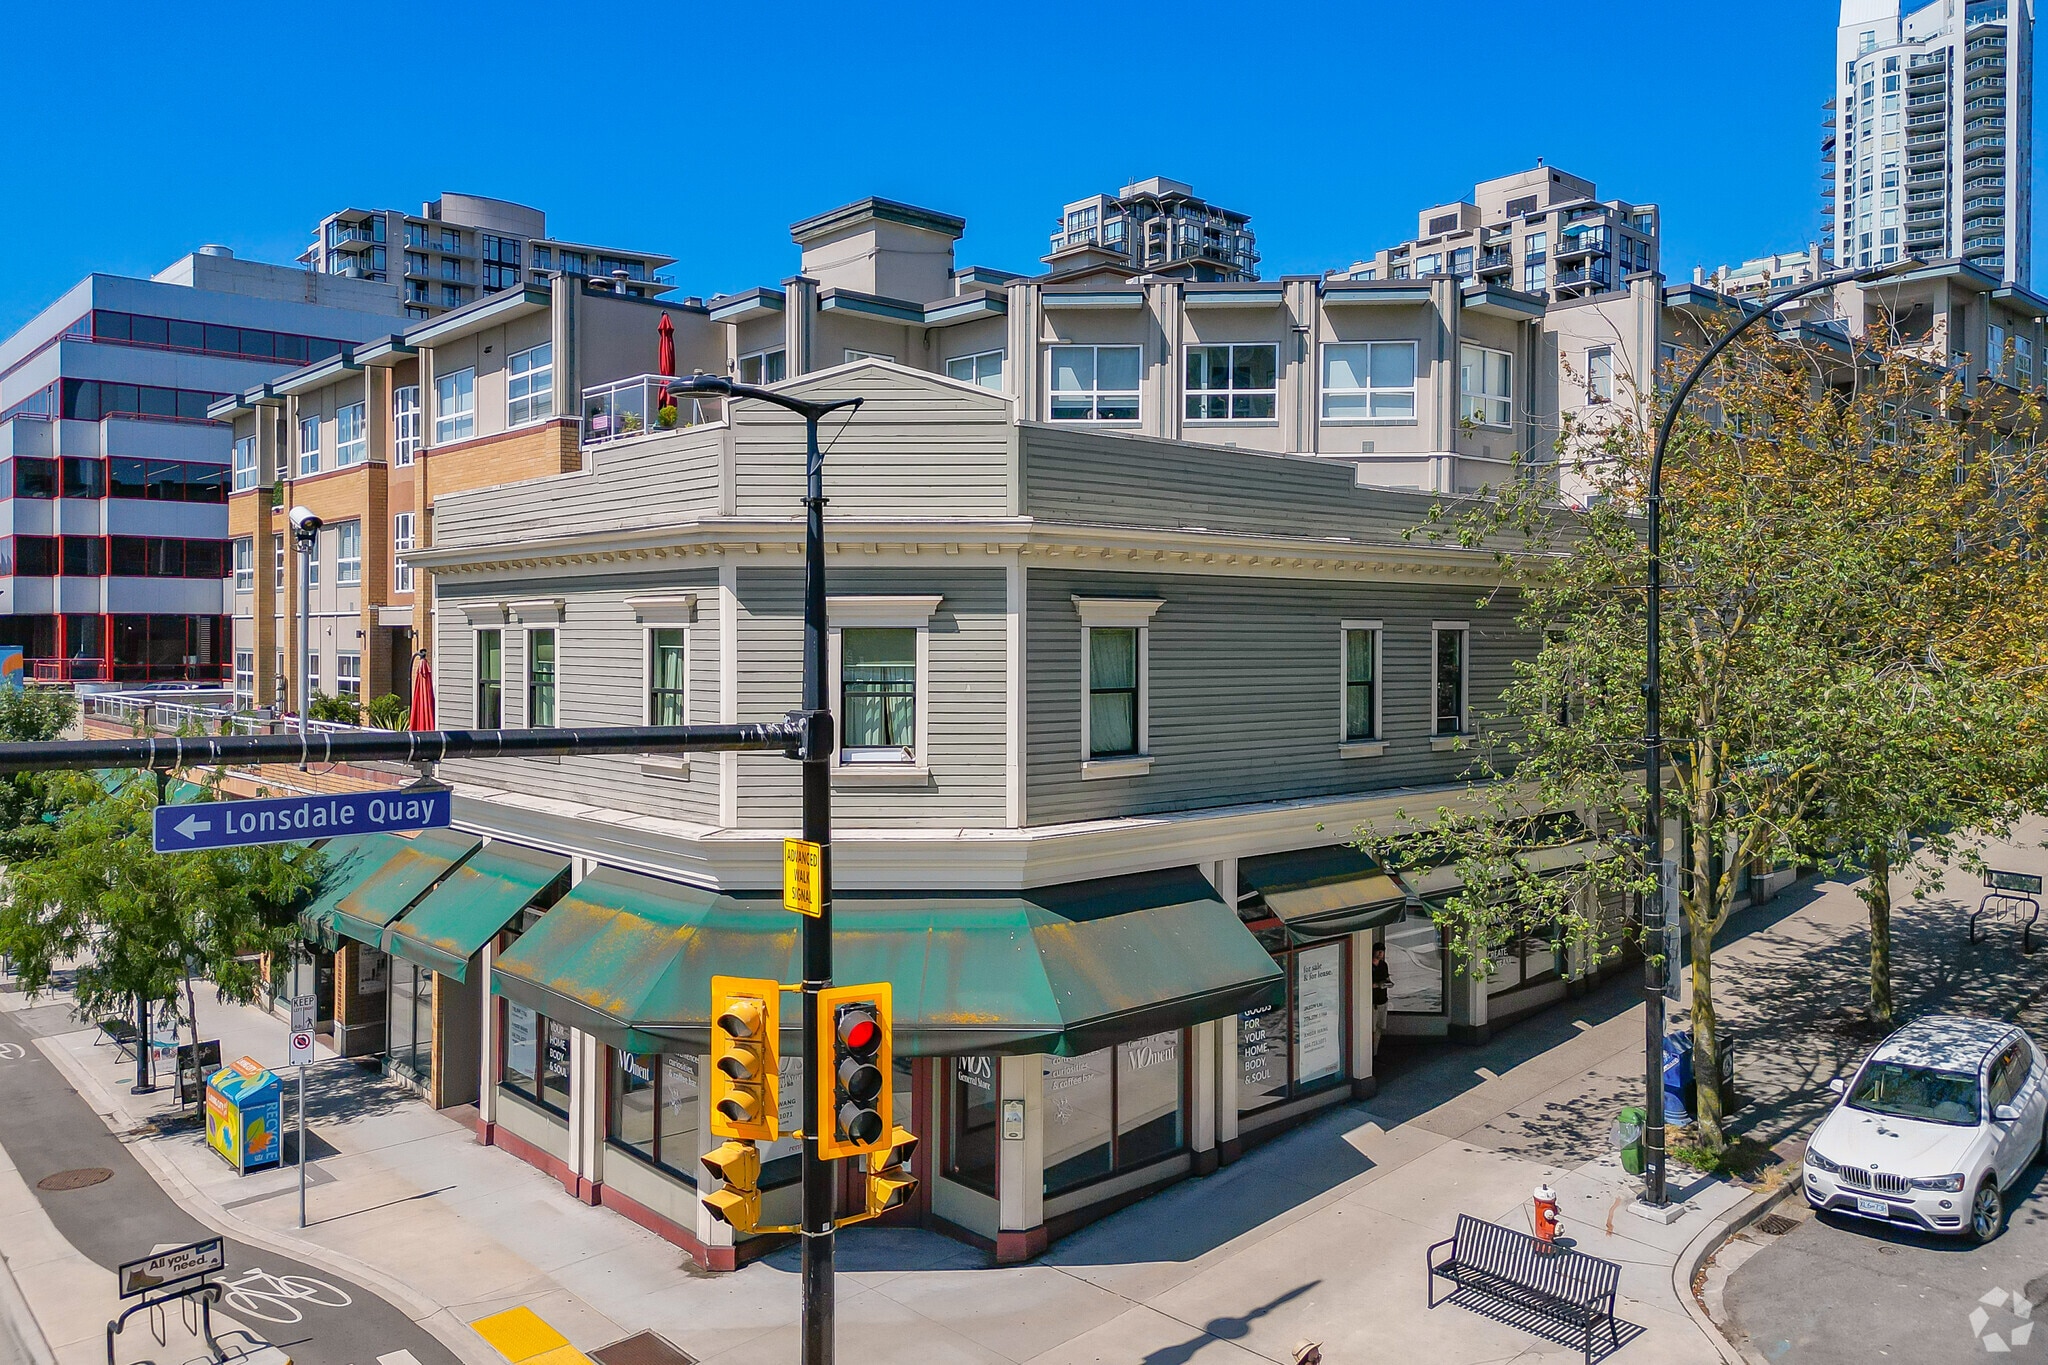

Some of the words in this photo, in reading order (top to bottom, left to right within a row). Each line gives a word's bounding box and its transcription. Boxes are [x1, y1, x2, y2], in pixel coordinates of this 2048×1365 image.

[226, 801, 355, 835] Lonsdale
[368, 799, 435, 825] Quay
[787, 848, 818, 867] ADVANCED
[794, 868, 811, 884] WALK
[792, 886, 813, 904] SIGNAL
[293, 996, 314, 1007] KEEP
[549, 1020, 566, 1036] YOUR
[1244, 1018, 1260, 1031] FOR
[1244, 1030, 1266, 1044] YOUR
[1244, 1042, 1270, 1058] HOME,
[553, 1065, 568, 1078] SOUL
[1244, 1075, 1251, 1085] &
[1252, 1069, 1271, 1083] SOUL
[958, 1071, 978, 1086] General
[978, 1078, 991, 1091] Store
[1052, 1081, 1058, 1091] &
[1059, 1077, 1081, 1089] coffee
[265, 1101, 279, 1160] RECYCLE
[149, 1257, 165, 1272] All
[167, 1253, 190, 1268] you
[173, 1255, 208, 1272] need.
